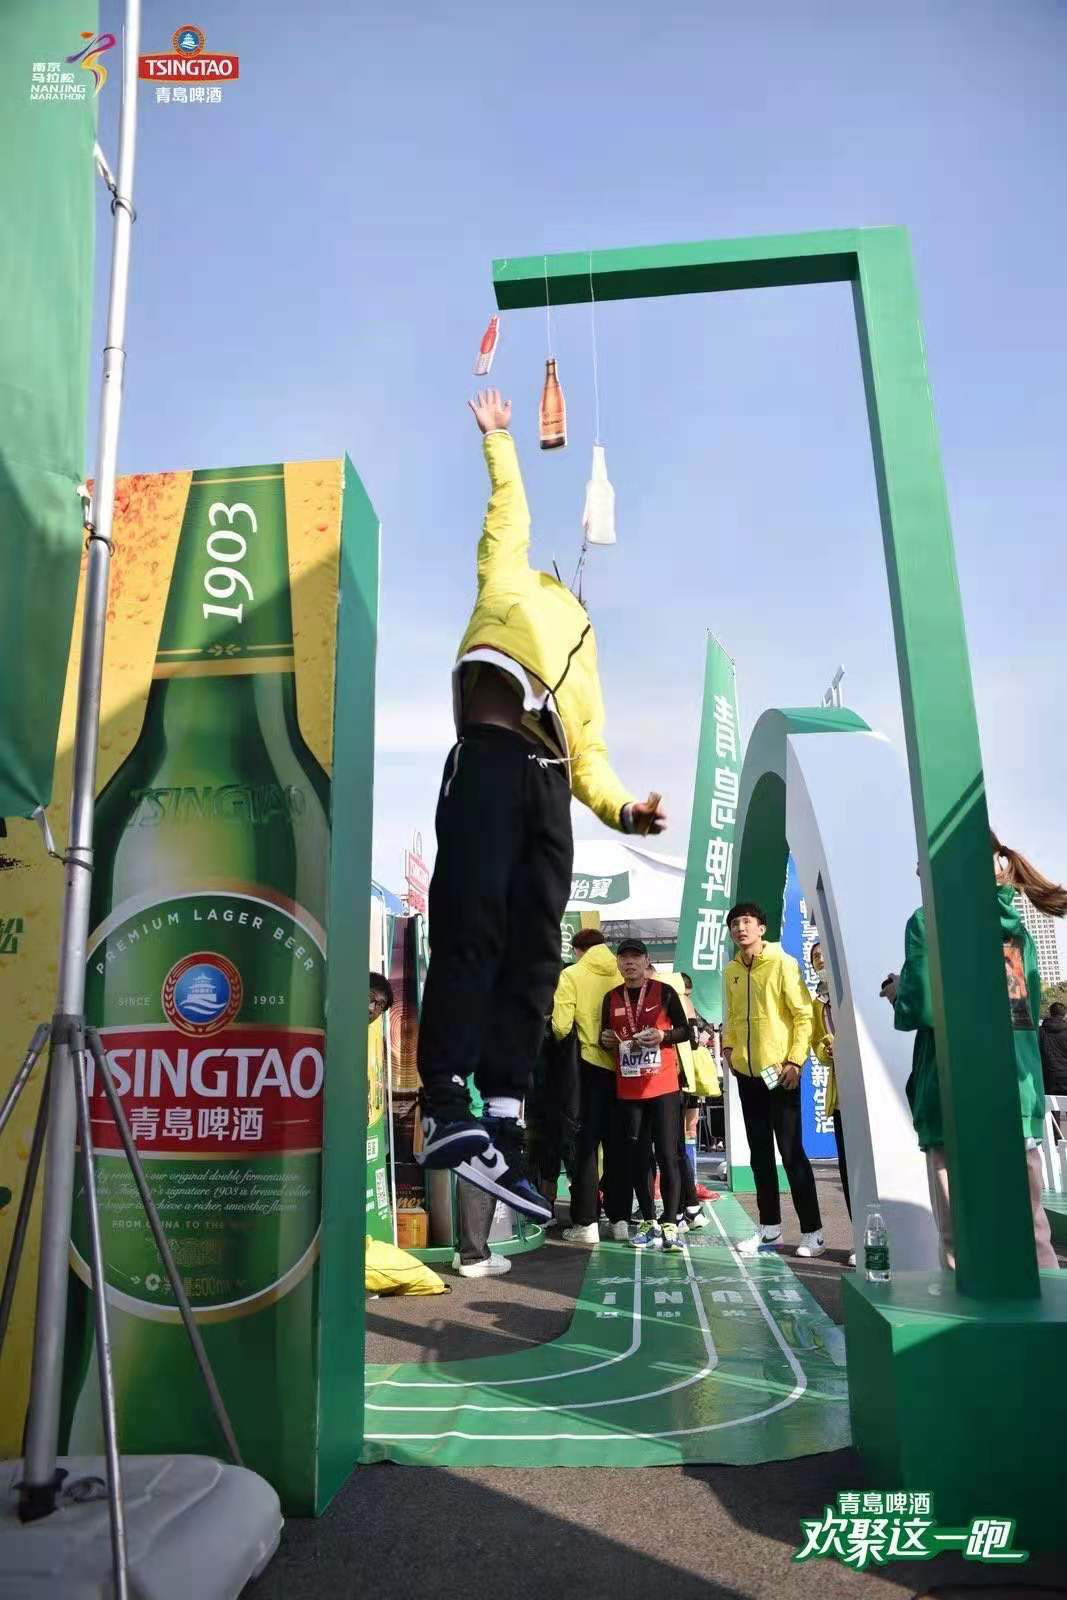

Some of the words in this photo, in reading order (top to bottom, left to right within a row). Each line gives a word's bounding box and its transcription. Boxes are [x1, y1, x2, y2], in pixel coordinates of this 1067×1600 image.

[202, 502, 258, 624] 1903
[96, 912, 180, 975] PREMIUM
[193, 909, 264, 930] LAGER
[272, 927, 315, 972] BEER
[118, 996, 153, 1006] SINCE
[253, 995, 285, 1006] 1903
[129, 1106, 264, 1141] 青島啤酒
[209, 1168, 239, 1181] double
[112, 1220, 142, 1229] FROM
[186, 1220, 200, 1229] TO
